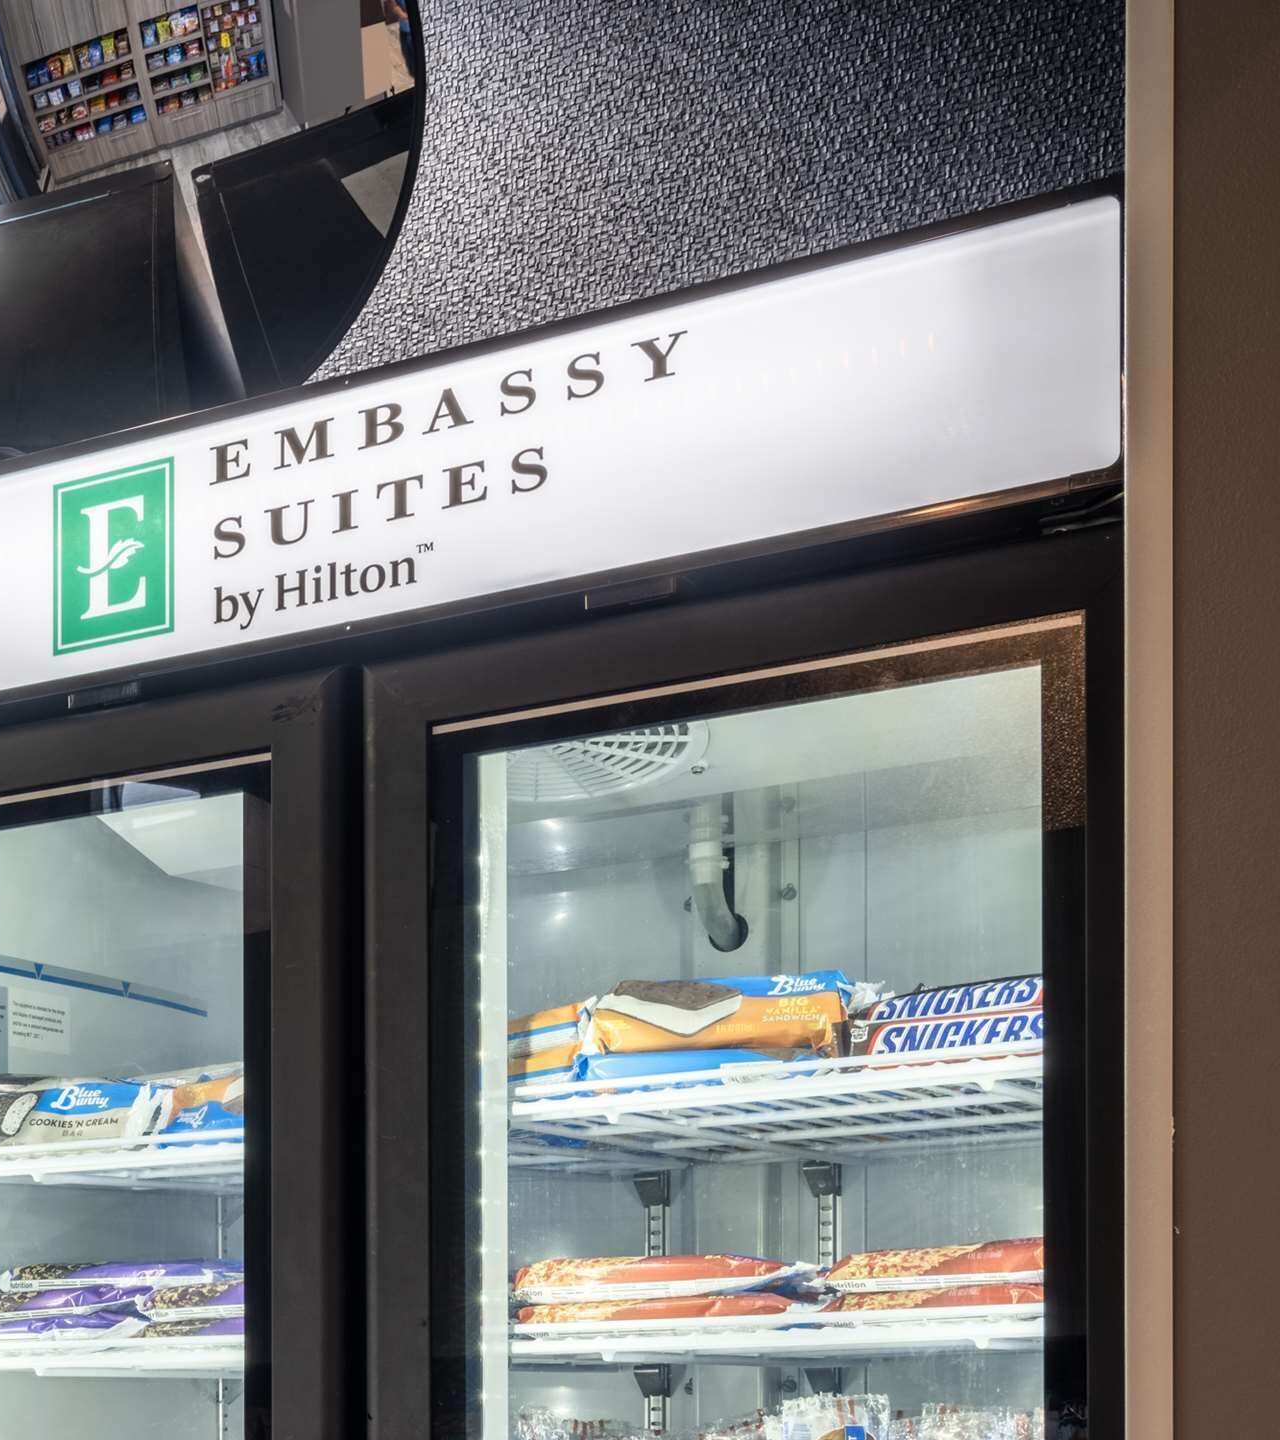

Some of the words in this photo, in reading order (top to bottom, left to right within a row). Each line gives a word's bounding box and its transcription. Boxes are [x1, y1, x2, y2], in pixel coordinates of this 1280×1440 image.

[209, 330, 688, 485] EMBASSY
[213, 447, 548, 560] SUITES
[214, 584, 263, 630] by
[779, 996, 809, 1008] BIG
[877, 976, 1041, 1021] SNICKERS
[762, 1013, 820, 1024] SANDWICH
[766, 1005, 818, 1015] VANILLA
[51, 1086, 102, 1109] Blue
[29, 1117, 73, 1129] COOKIES
[86, 1117, 119, 1127] CREAM
[61, 1129, 83, 1137] BAR
